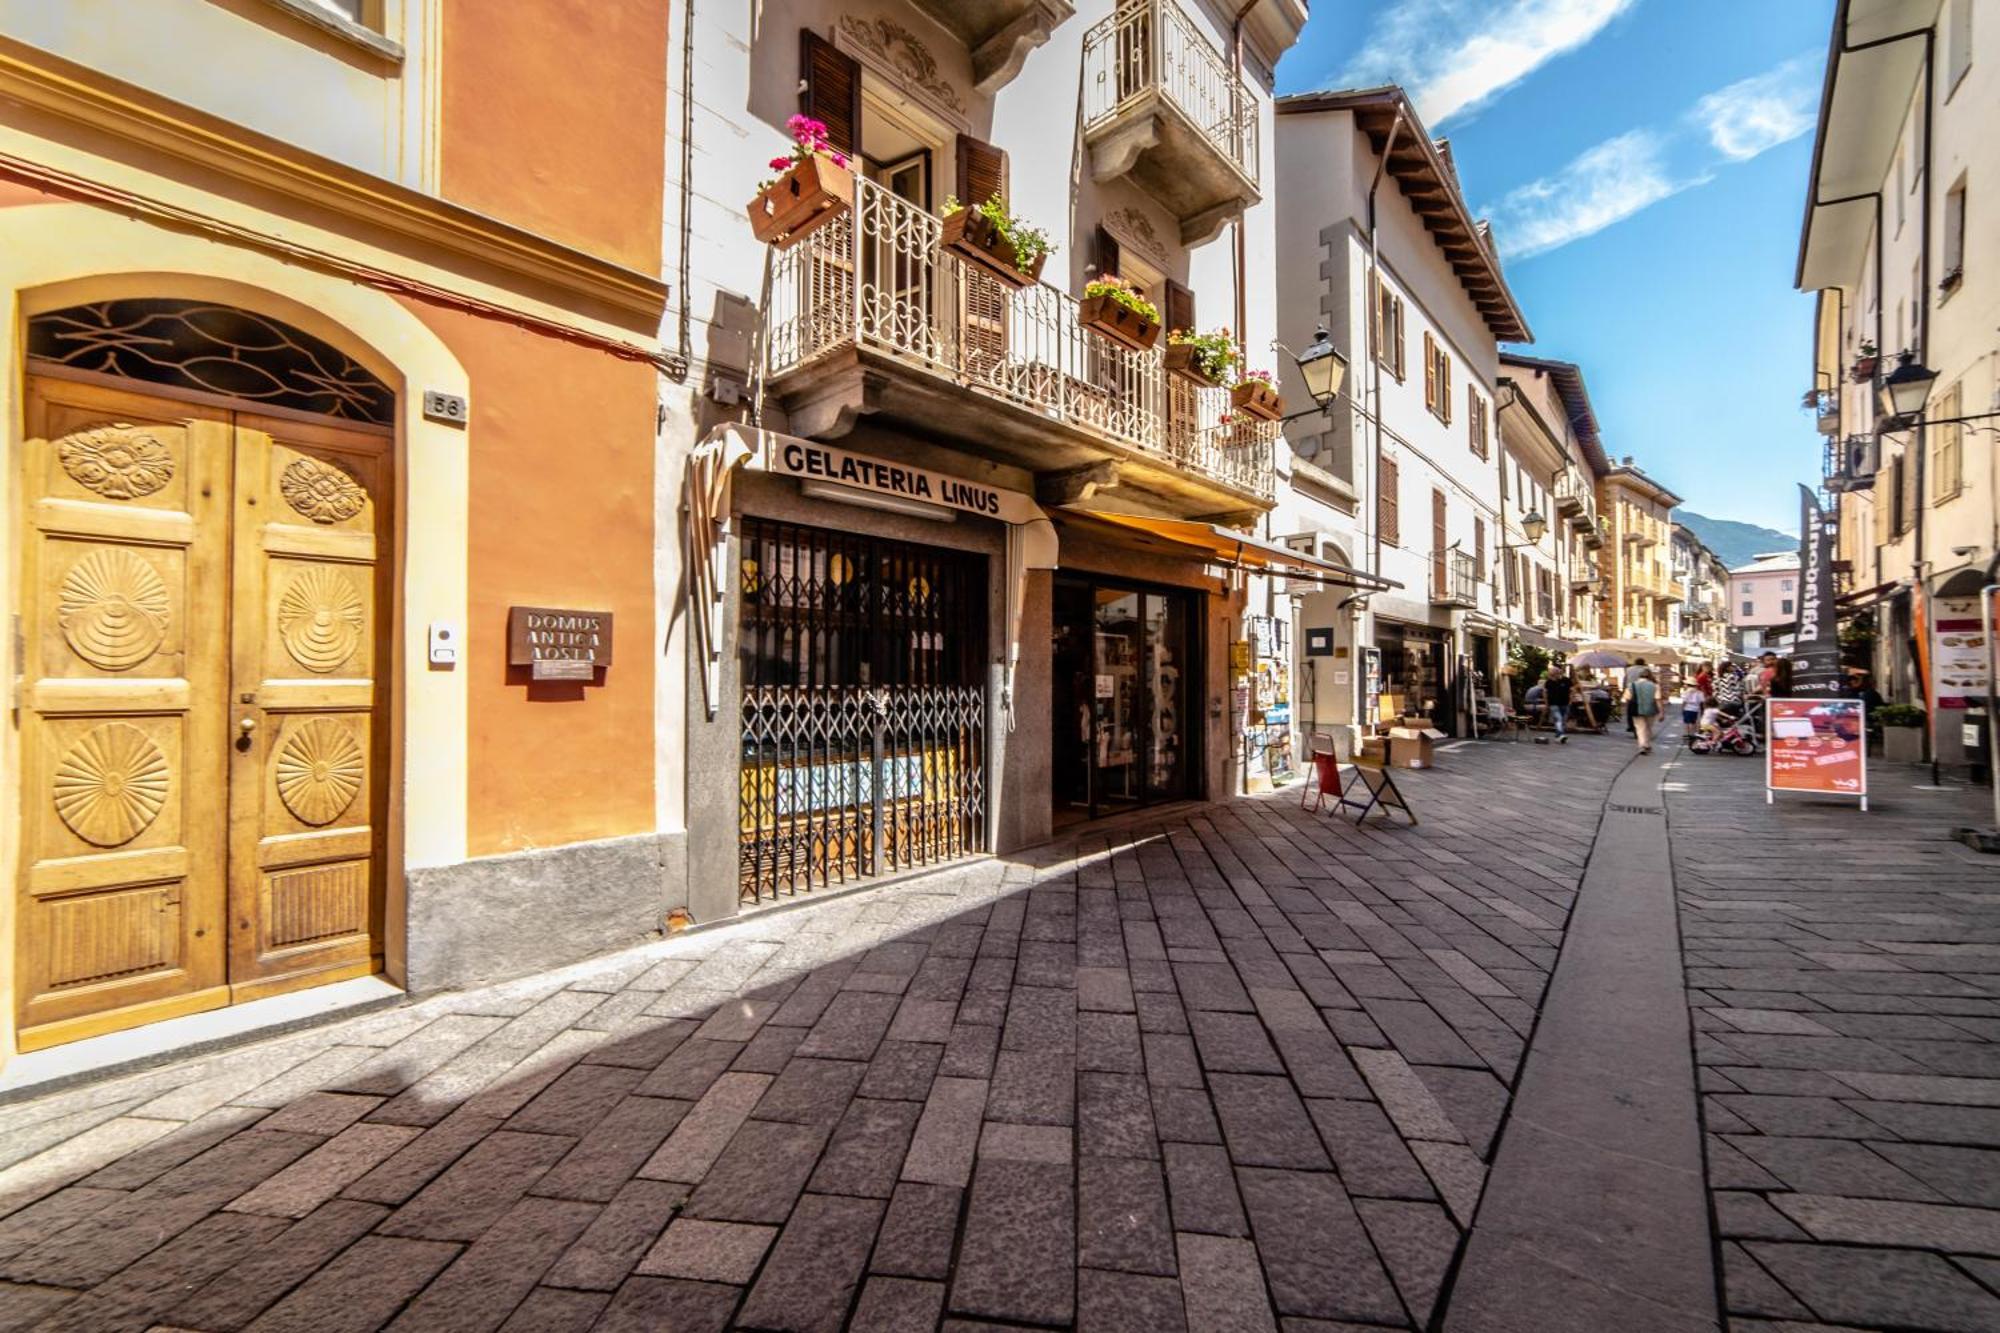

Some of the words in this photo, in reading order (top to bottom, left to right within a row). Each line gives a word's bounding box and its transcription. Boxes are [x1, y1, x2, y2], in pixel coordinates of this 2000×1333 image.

[783, 444, 932, 499] GELATERIA
[941, 480, 999, 514] LINUS
[527, 612, 600, 631] DOMUS
[527, 631, 600, 647] ANTICA
[531, 646, 597, 661] AOSTA
